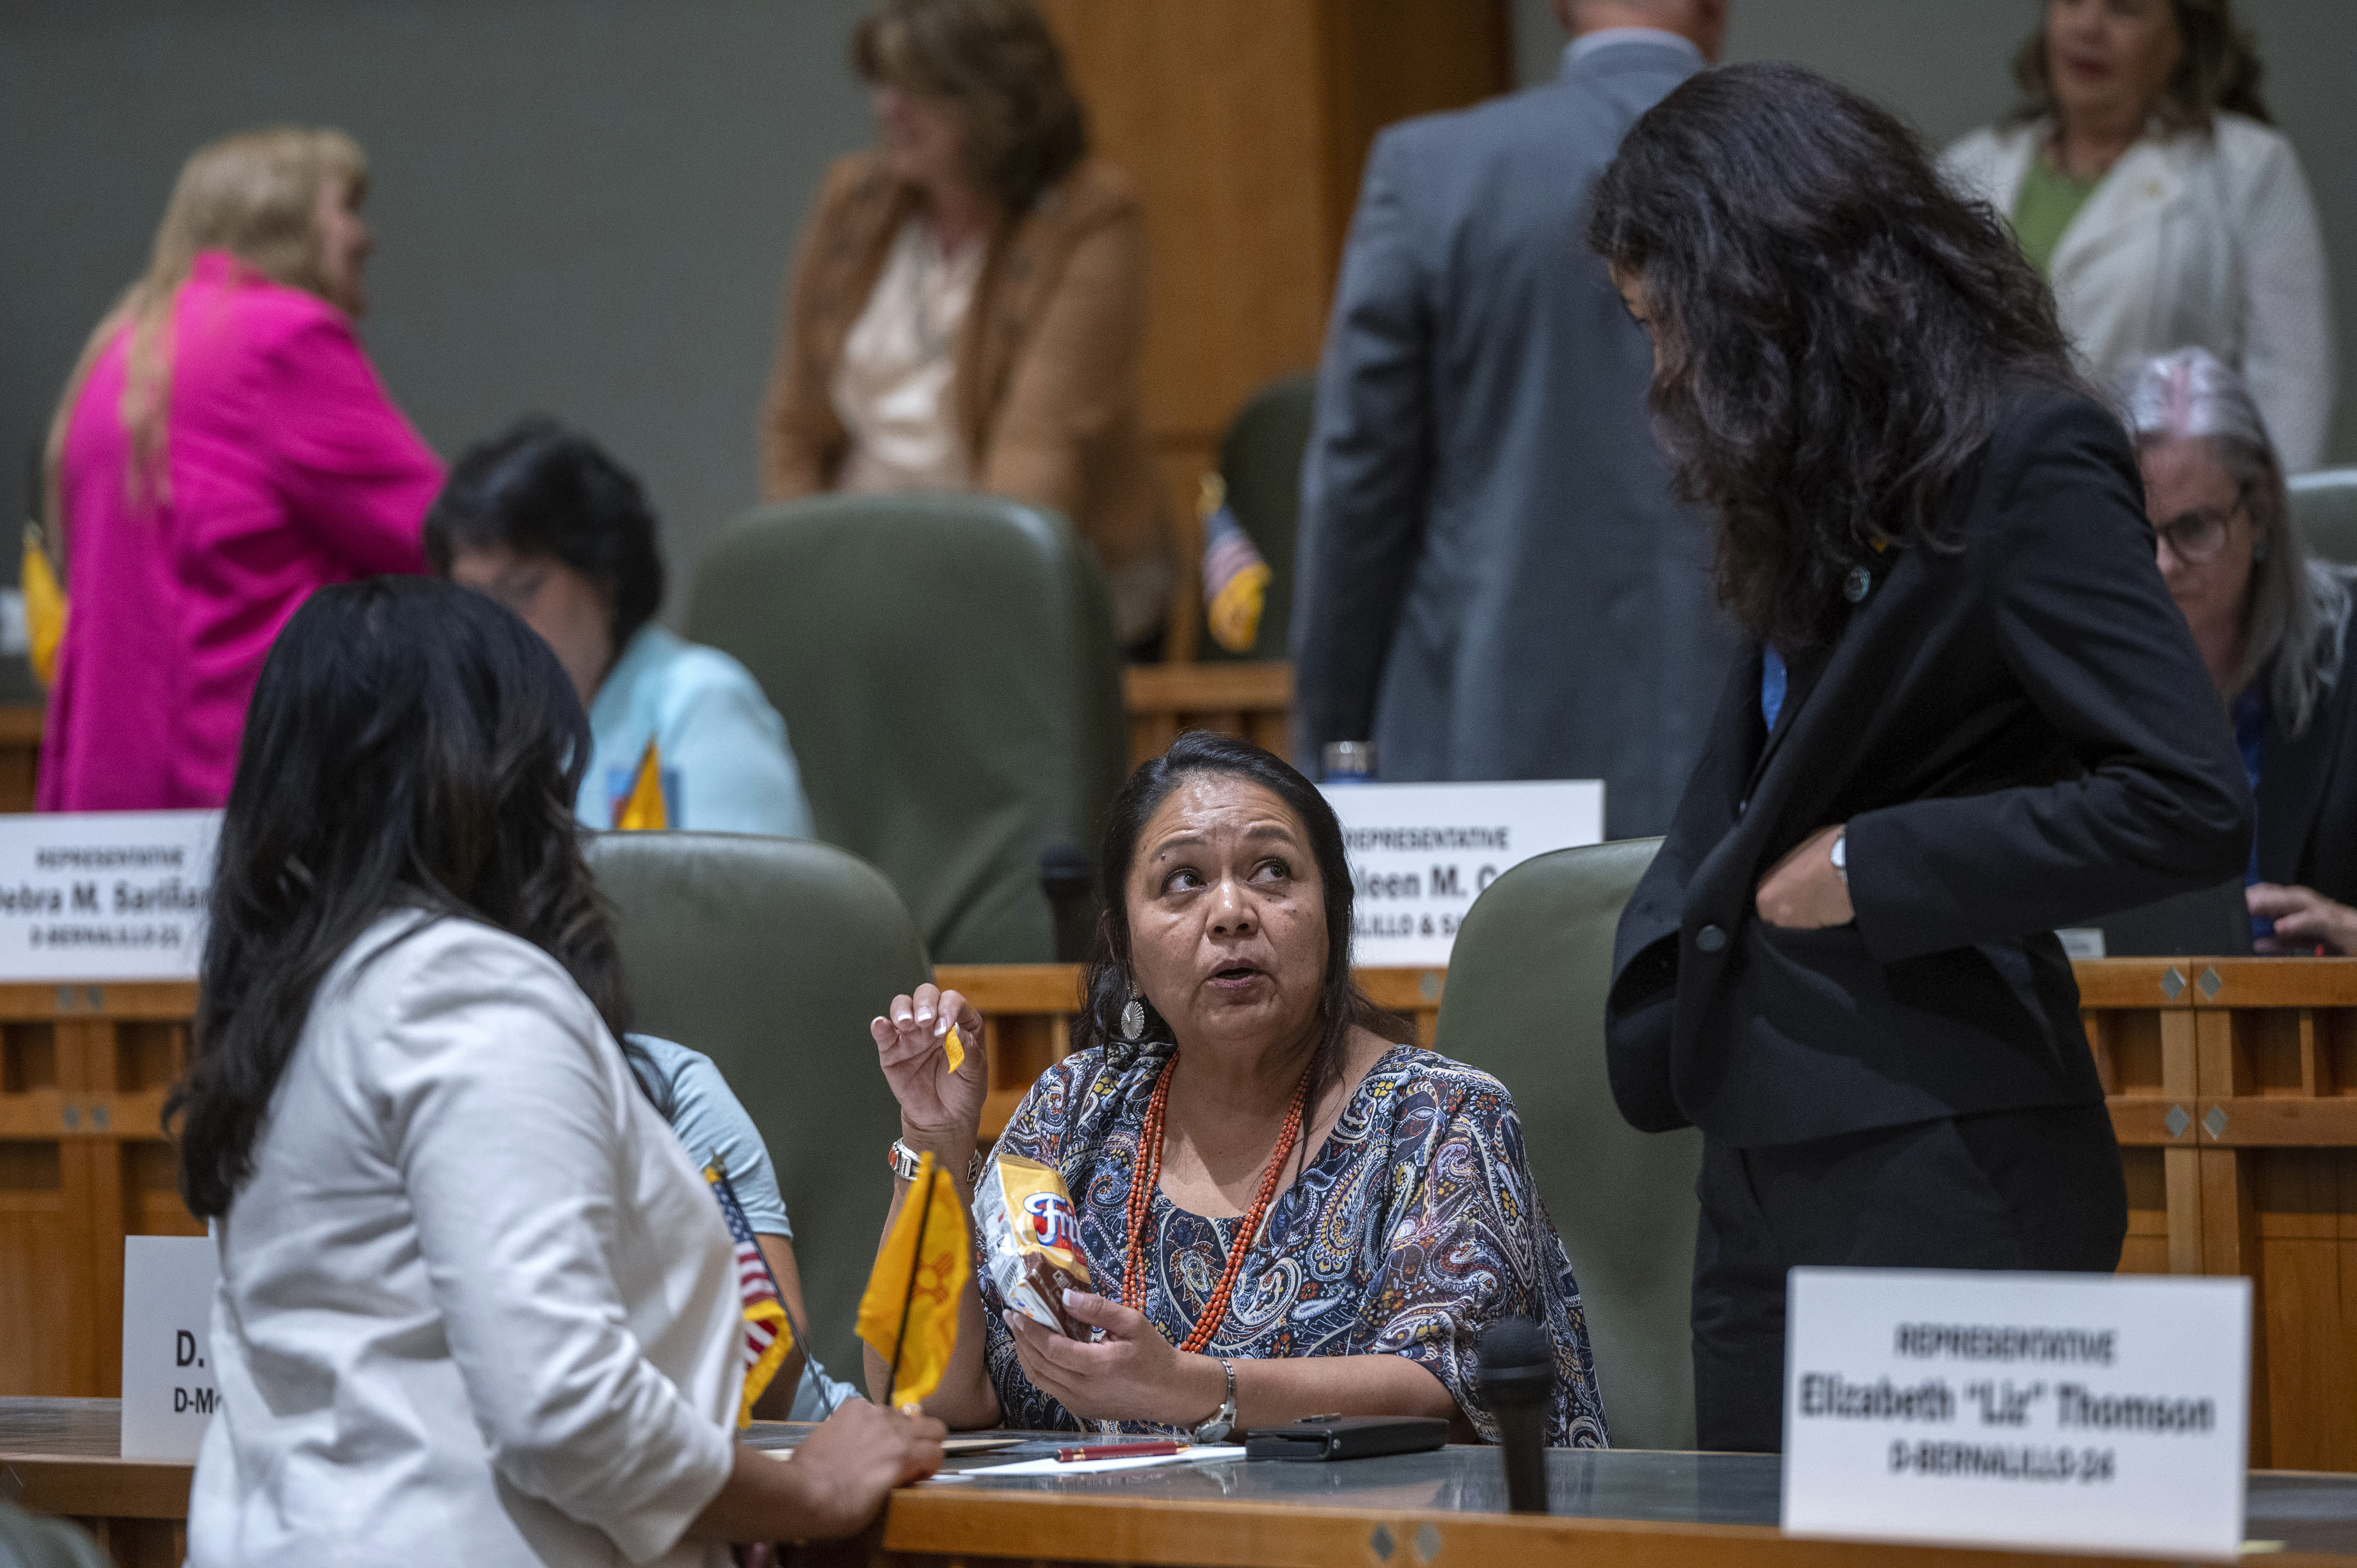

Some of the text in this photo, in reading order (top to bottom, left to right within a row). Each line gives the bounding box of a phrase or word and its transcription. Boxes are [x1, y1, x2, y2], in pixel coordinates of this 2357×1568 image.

[1346, 826, 1510, 851] REPRESENTATIVE
[36, 845, 184, 871] REPRESENTATIVE
[0, 879, 63, 914] ebra
[71, 879, 101, 914] M.
[1353, 863, 1422, 899] leen
[1429, 863, 1468, 899] M.
[1355, 912, 1415, 938] LILLO
[1419, 911, 1436, 939] &
[177, 1329, 205, 1367] D.
[1894, 1323, 2119, 1368] REPRESENTATIVE
[1797, 1370, 1957, 1425] Elizabeth
[2056, 1381, 2219, 1436] Thomson
[1889, 1437, 2118, 1485] D-BERNALILLO-24
